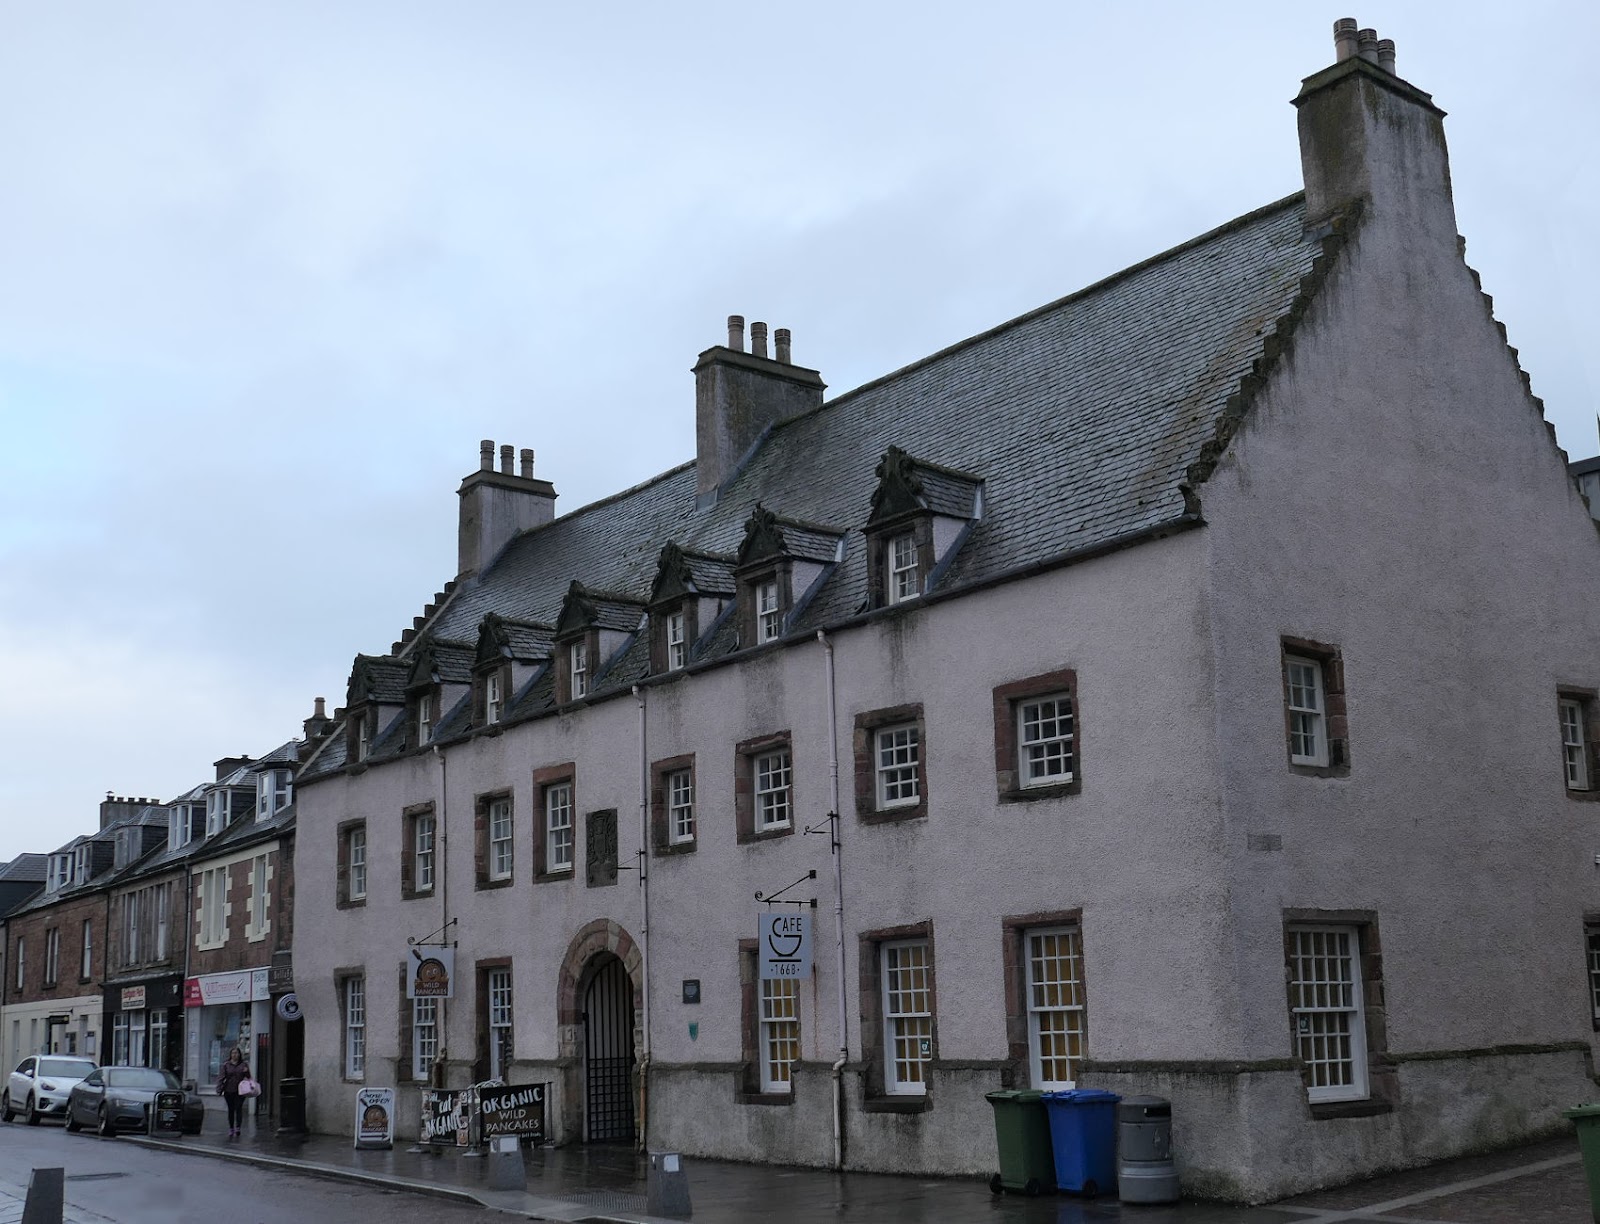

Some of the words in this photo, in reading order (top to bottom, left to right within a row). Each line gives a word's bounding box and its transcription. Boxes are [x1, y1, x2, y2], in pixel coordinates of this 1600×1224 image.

[772, 917, 802, 937] CAFE
[482, 1087, 542, 1113] ORGANIC
[498, 1109, 526, 1119] WILD
[485, 1119, 540, 1132] PANCAKES
